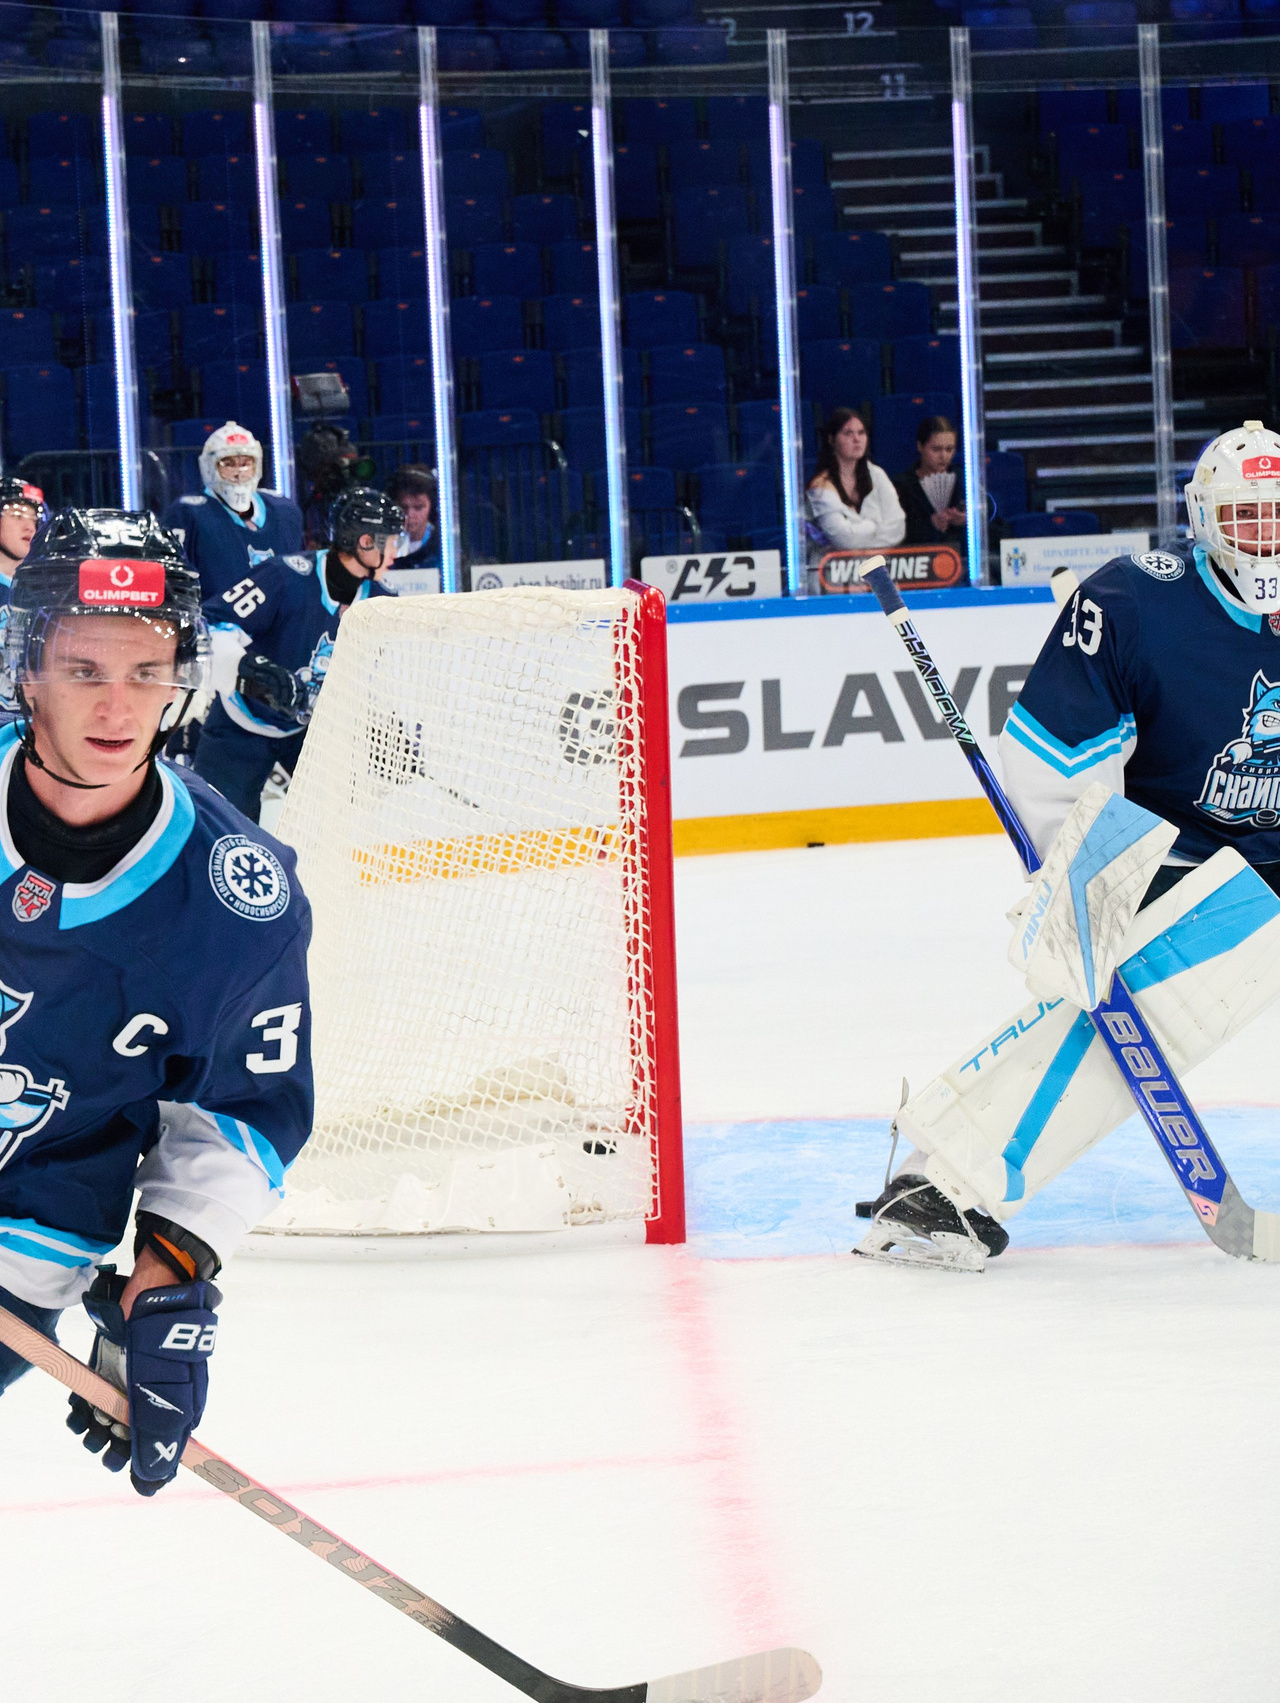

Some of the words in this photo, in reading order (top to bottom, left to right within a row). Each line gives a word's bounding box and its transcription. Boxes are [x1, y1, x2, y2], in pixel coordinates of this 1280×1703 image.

[843, 11, 875, 36] 12
[830, 556, 930, 584] WIINE
[1255, 577, 1279, 600] 33
[83, 588, 159, 603] OLIMPBET
[222, 577, 267, 619] 56
[1062, 590, 1104, 657] 33
[895, 618, 977, 745] SHADOW
[24, 880, 49, 899] МХЛ
[112, 1013, 169, 1058] C
[245, 1001, 303, 1075] 3
[193, 1458, 426, 1610] SOYUZ
